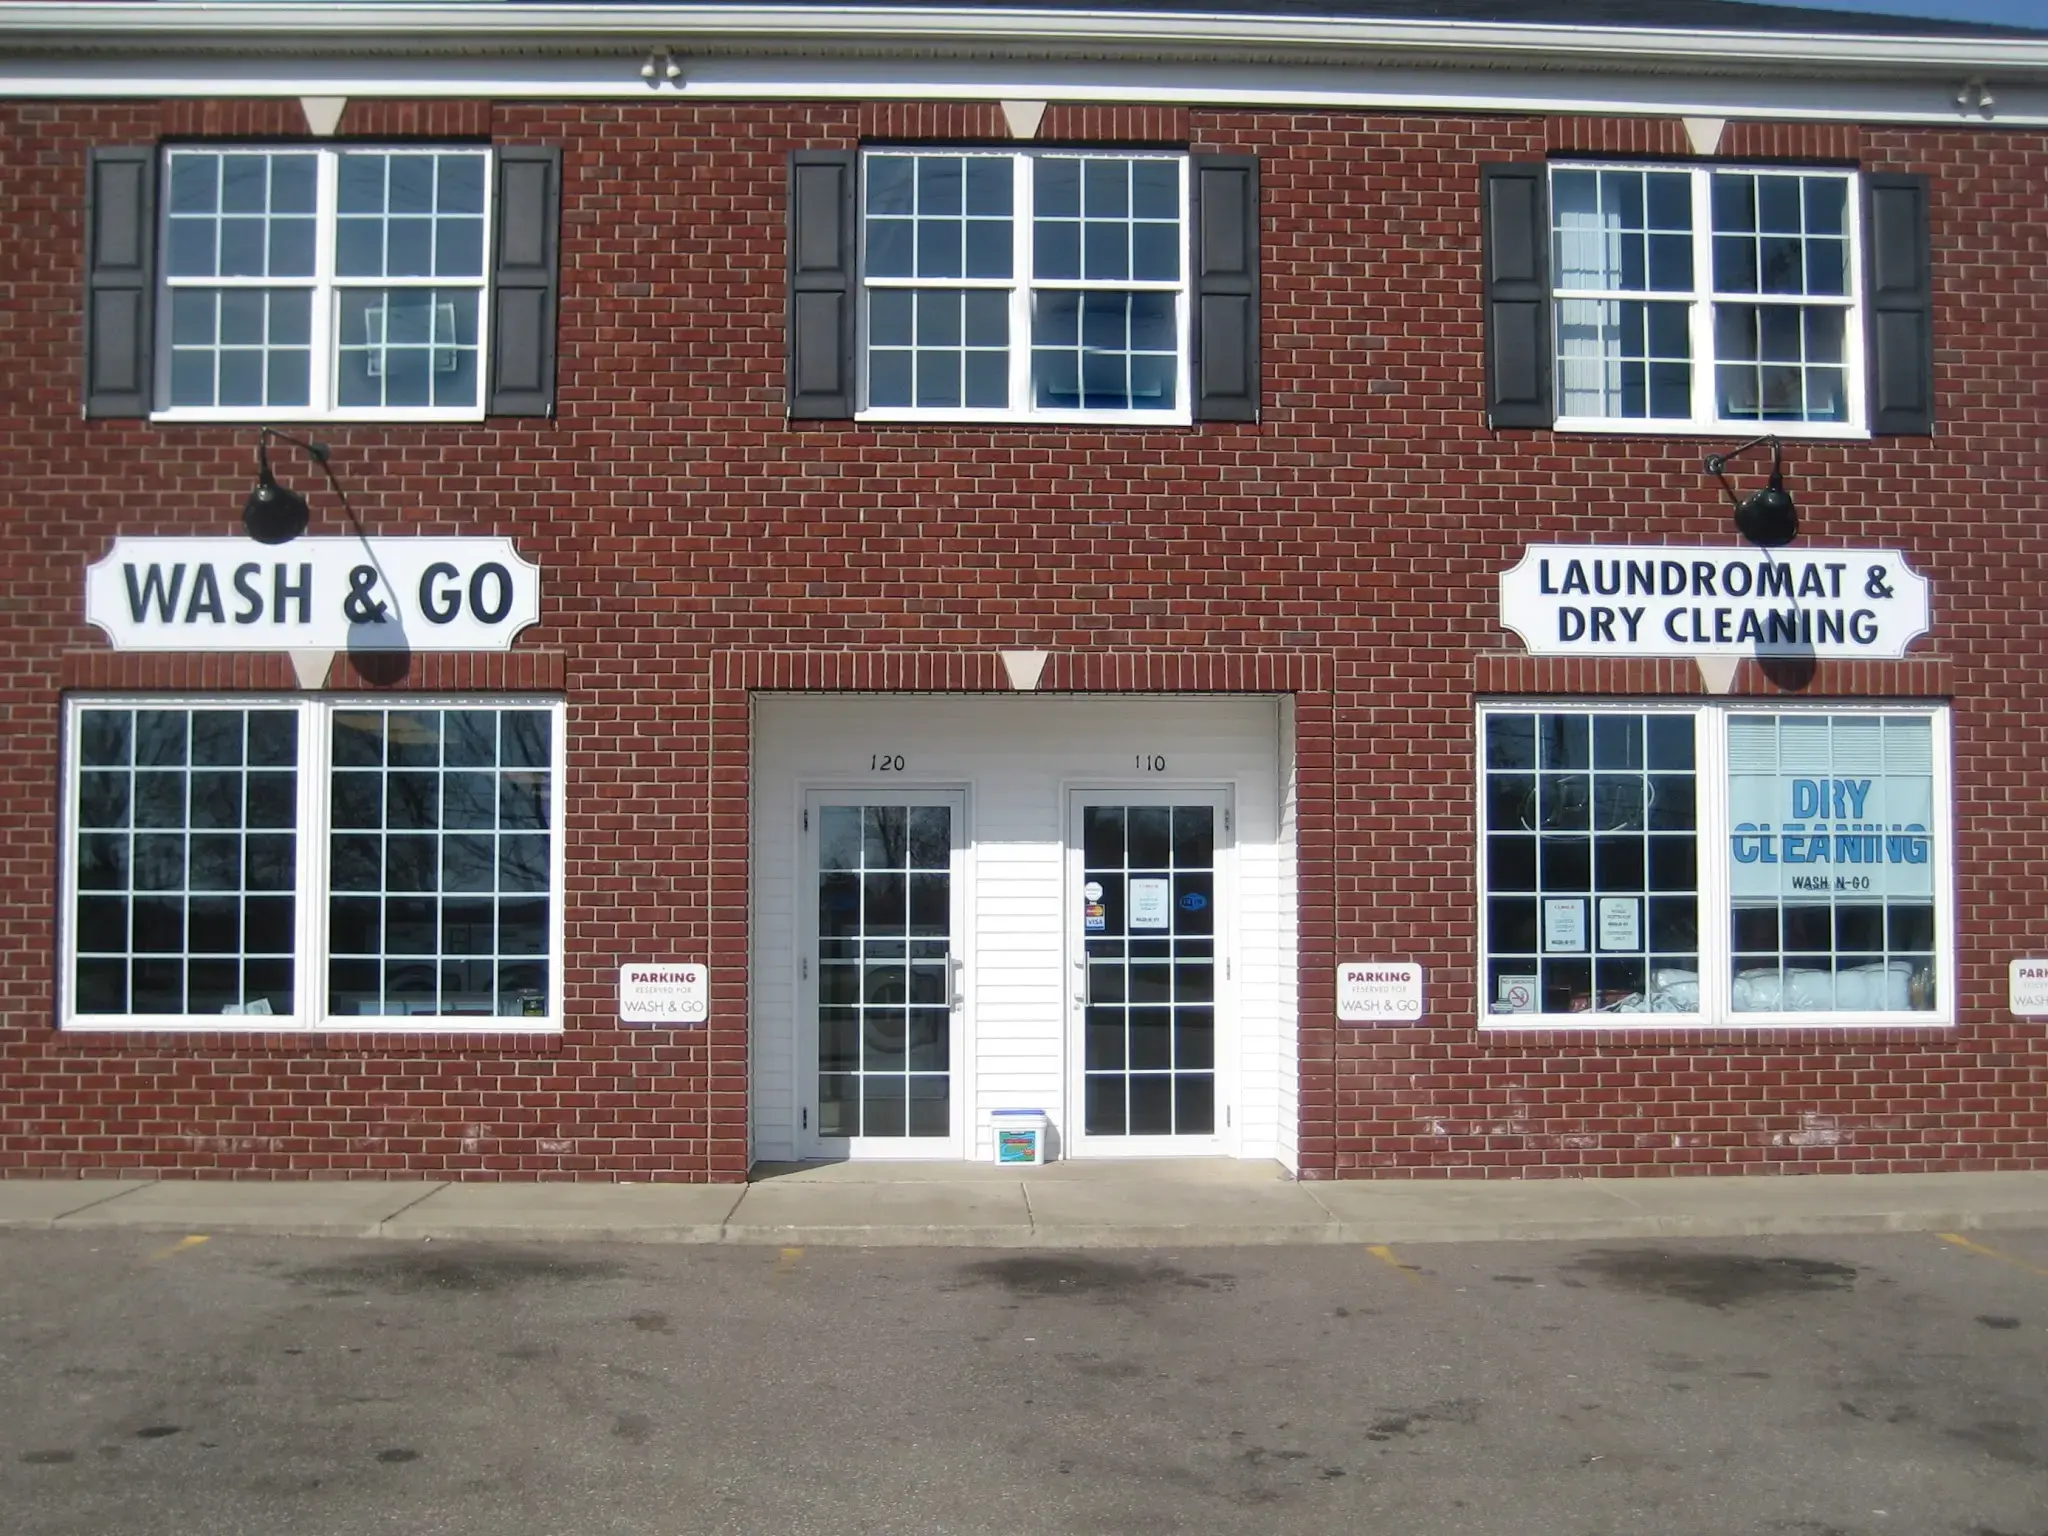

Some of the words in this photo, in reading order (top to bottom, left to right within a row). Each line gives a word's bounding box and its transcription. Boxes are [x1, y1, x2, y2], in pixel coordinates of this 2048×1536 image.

[1539, 558, 1846, 598] LAUNDROMAT
[1865, 564, 1894, 599] &
[123, 562, 313, 624] WASH
[343, 564, 388, 625] &
[418, 561, 514, 624] GO
[1558, 606, 1646, 643] DRY
[1664, 607, 1879, 644] CLEANING
[870, 754, 906, 772] 120
[1135, 754, 1166, 772] 110
[1792, 779, 1872, 819] DRY
[1732, 822, 1928, 864] CLEANING
[631, 972, 697, 983] PARKING
[1347, 971, 1412, 982] PARKING
[635, 986, 674, 994] RESERVED
[676, 986, 692, 994] FOR
[1352, 985, 1389, 993] RESERVED
[1391, 985, 1407, 993] FOR
[624, 1000, 664, 1013] WASH
[668, 1000, 677, 1013] &
[681, 1000, 704, 1013] GO
[1341, 999, 1380, 1011] WASH
[1384, 999, 1393, 1011] &
[1396, 999, 1419, 1011] GO
